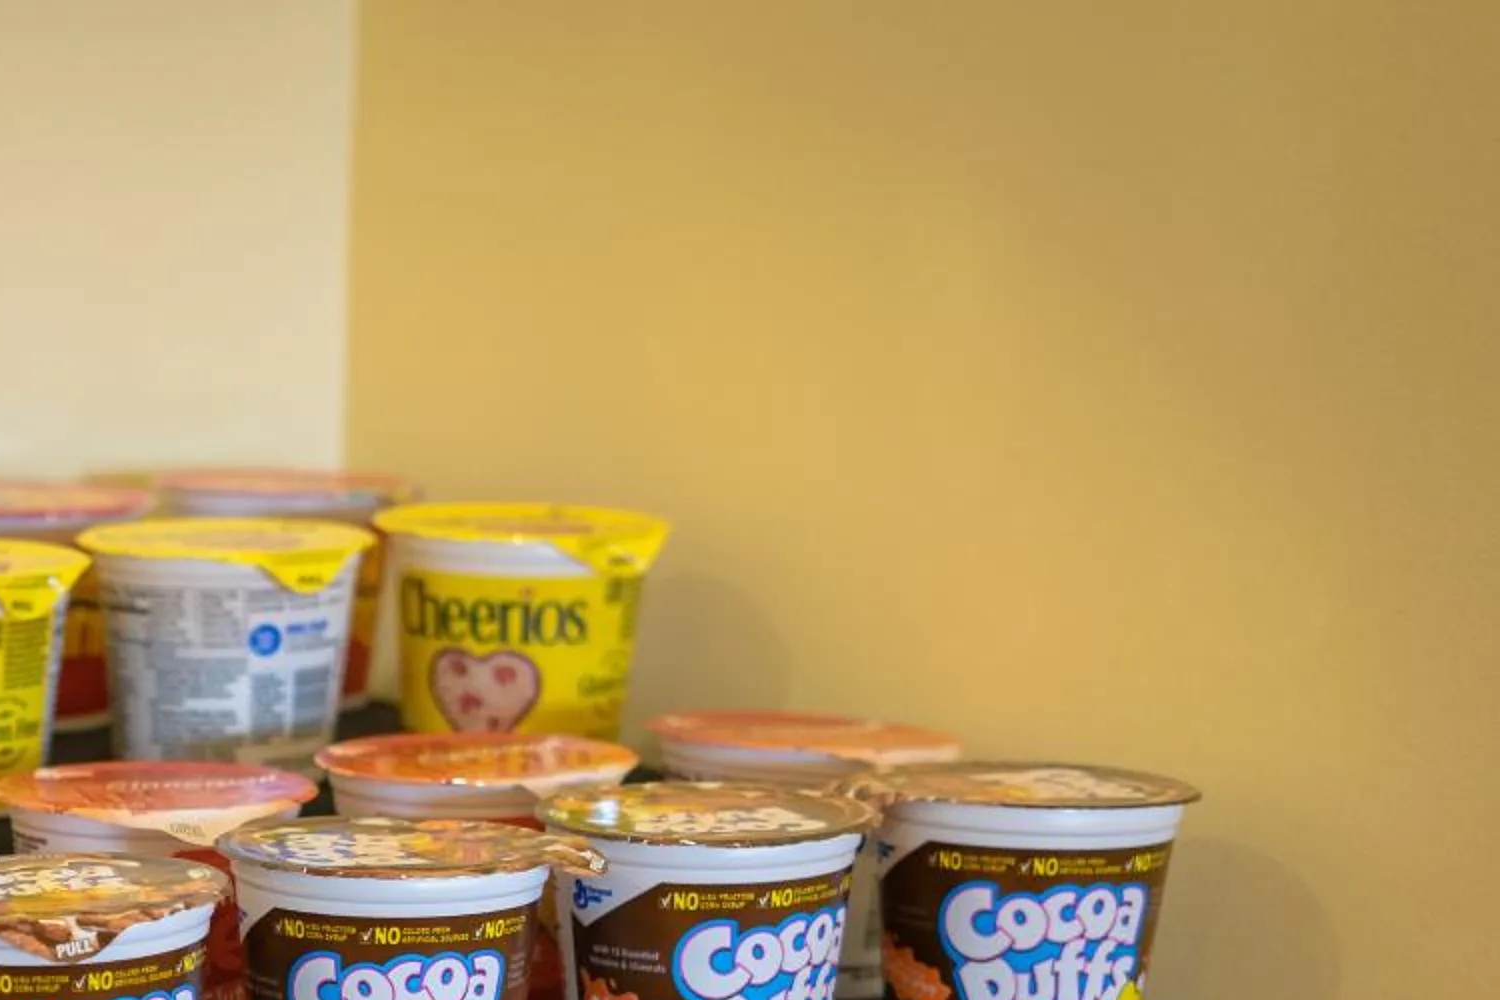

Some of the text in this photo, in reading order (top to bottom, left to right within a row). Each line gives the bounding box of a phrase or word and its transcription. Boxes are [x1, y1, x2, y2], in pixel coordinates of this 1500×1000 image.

[402, 575, 587, 645] Cheerios
[939, 852, 962, 870] NO
[1032, 857, 1059, 877] NO
[673, 892, 699, 911] NO
[770, 887, 793, 908] NO
[283, 920, 305, 939] NO
[485, 919, 504, 939] NO
[944, 886, 1147, 962] Cocoa
[375, 927, 400, 945] NO
[56, 938, 95, 958] PULL
[87, 970, 113, 991] NO
